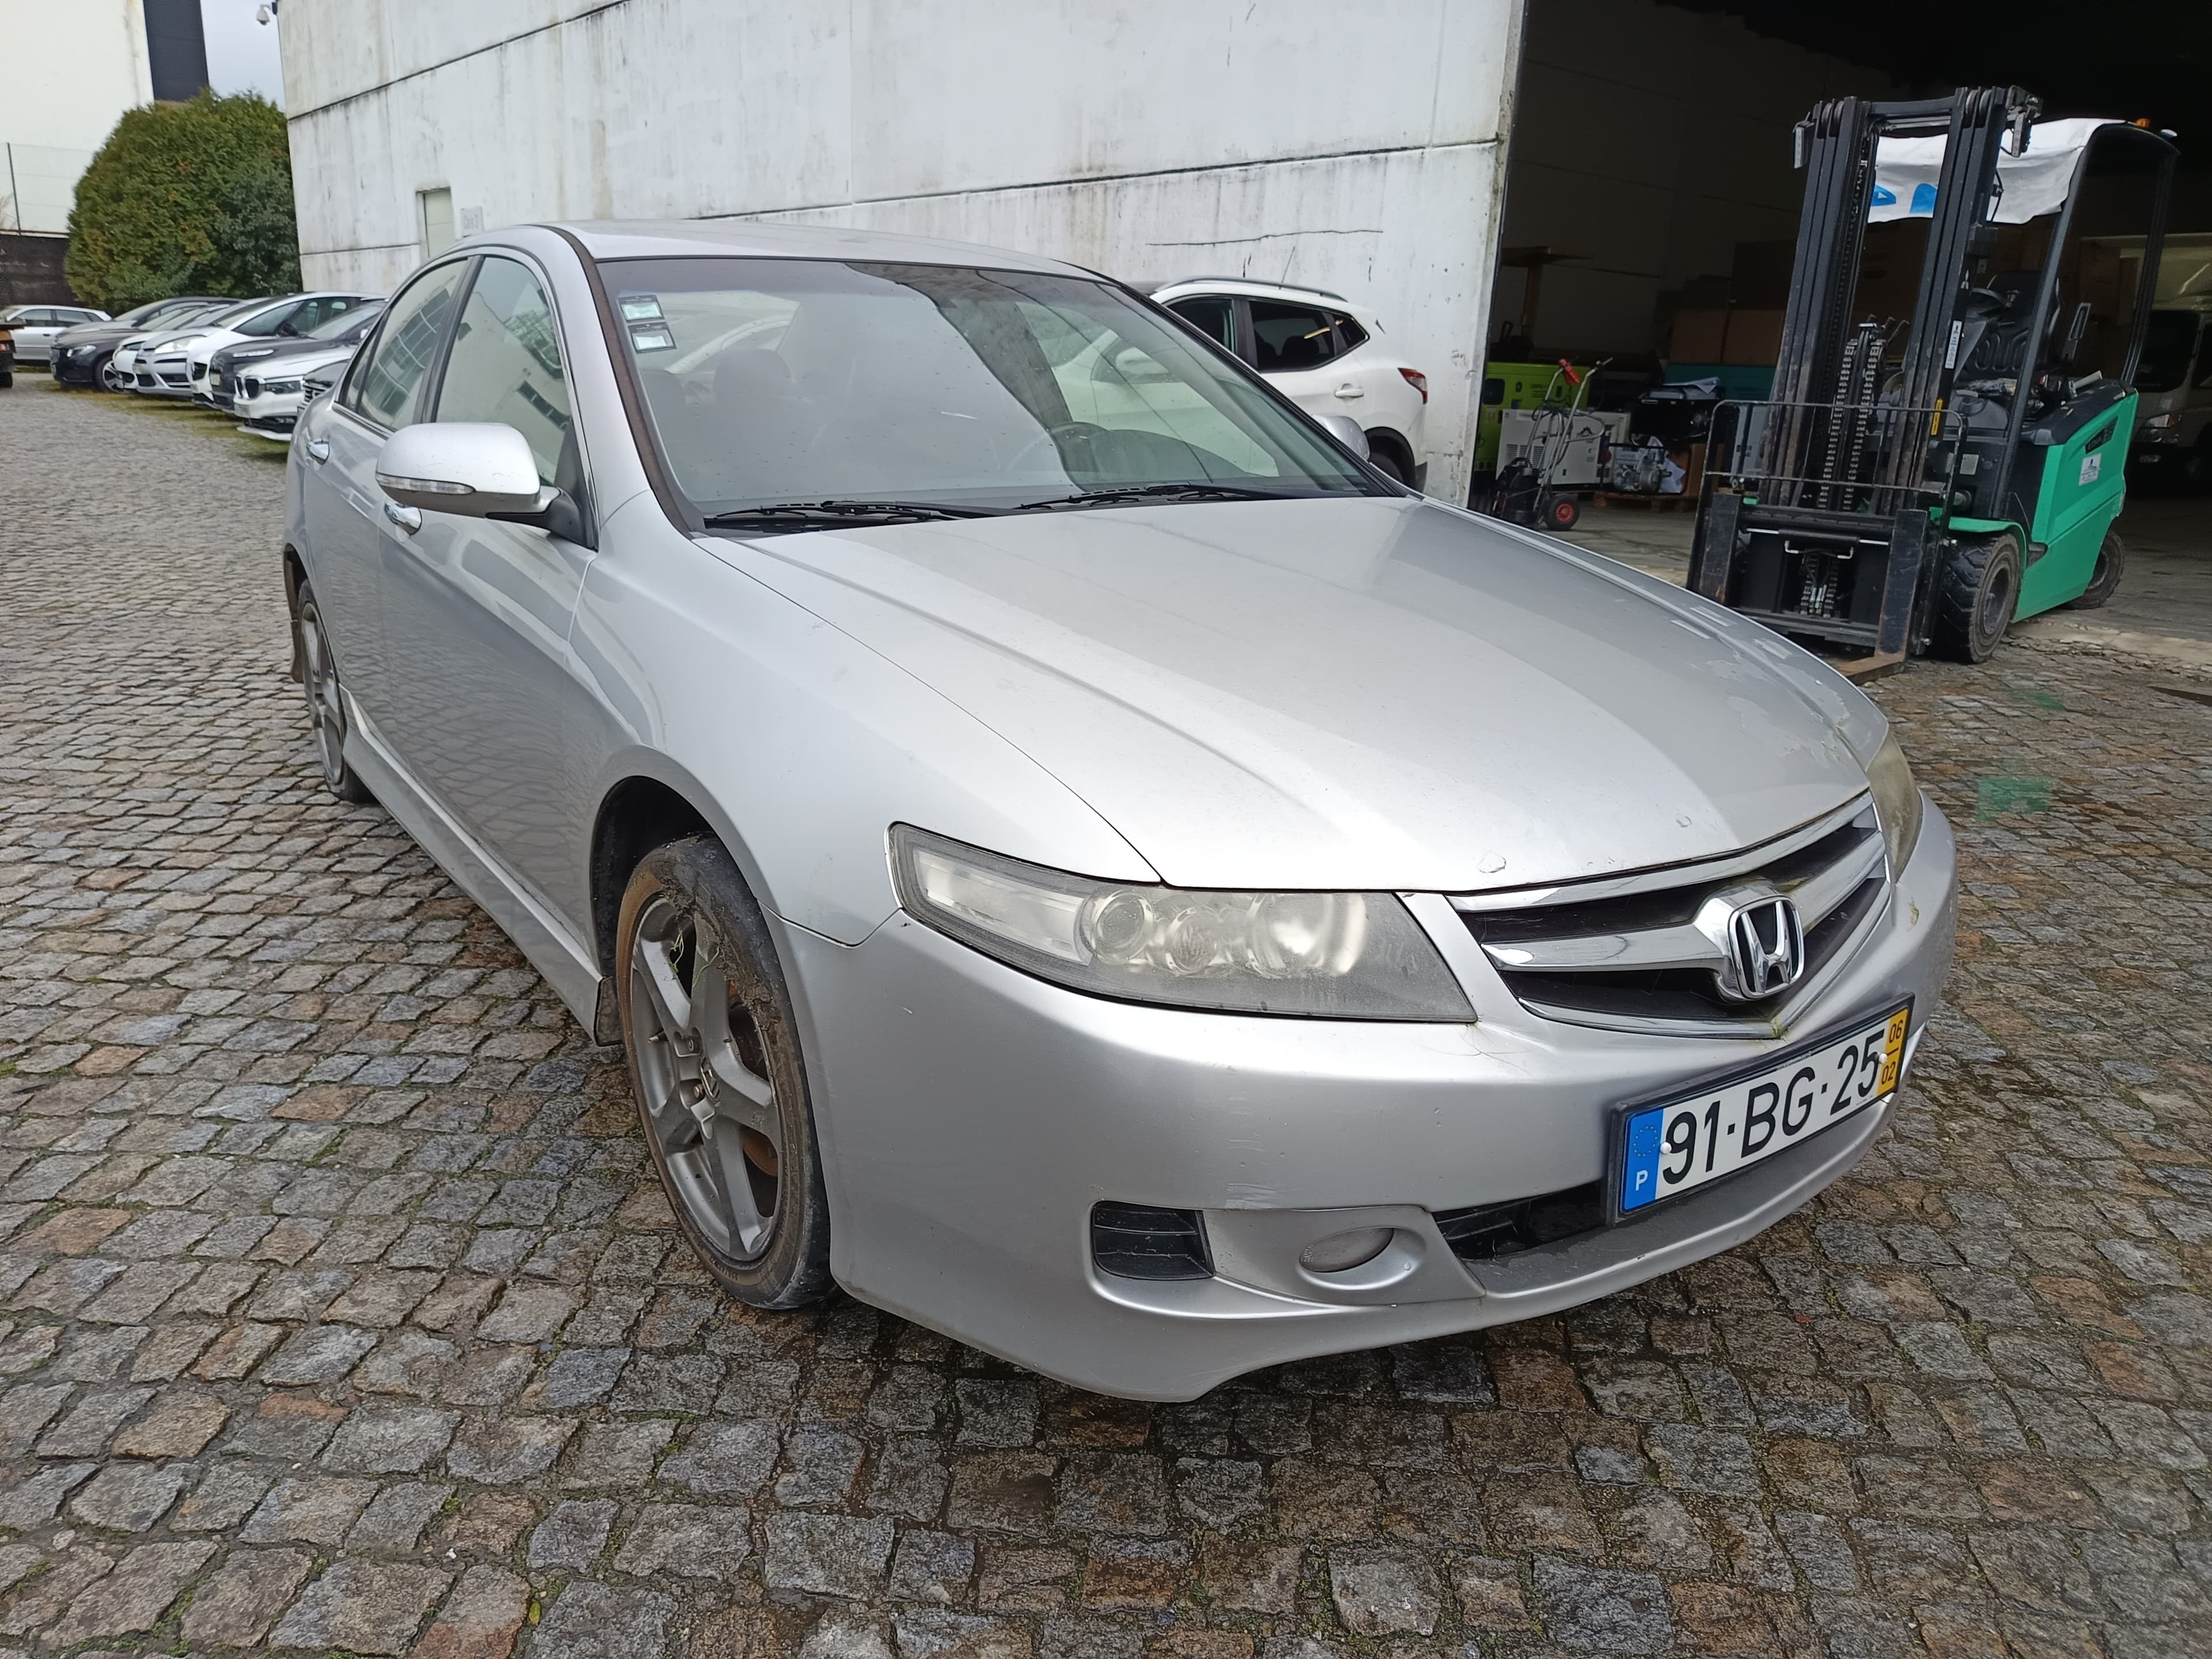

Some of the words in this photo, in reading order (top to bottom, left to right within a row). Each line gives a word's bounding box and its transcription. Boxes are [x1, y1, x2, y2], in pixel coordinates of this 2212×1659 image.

[1889, 1019, 1903, 1043] 06
[1881, 1064, 1894, 1086] 02
[1635, 1170, 1648, 1191] P
